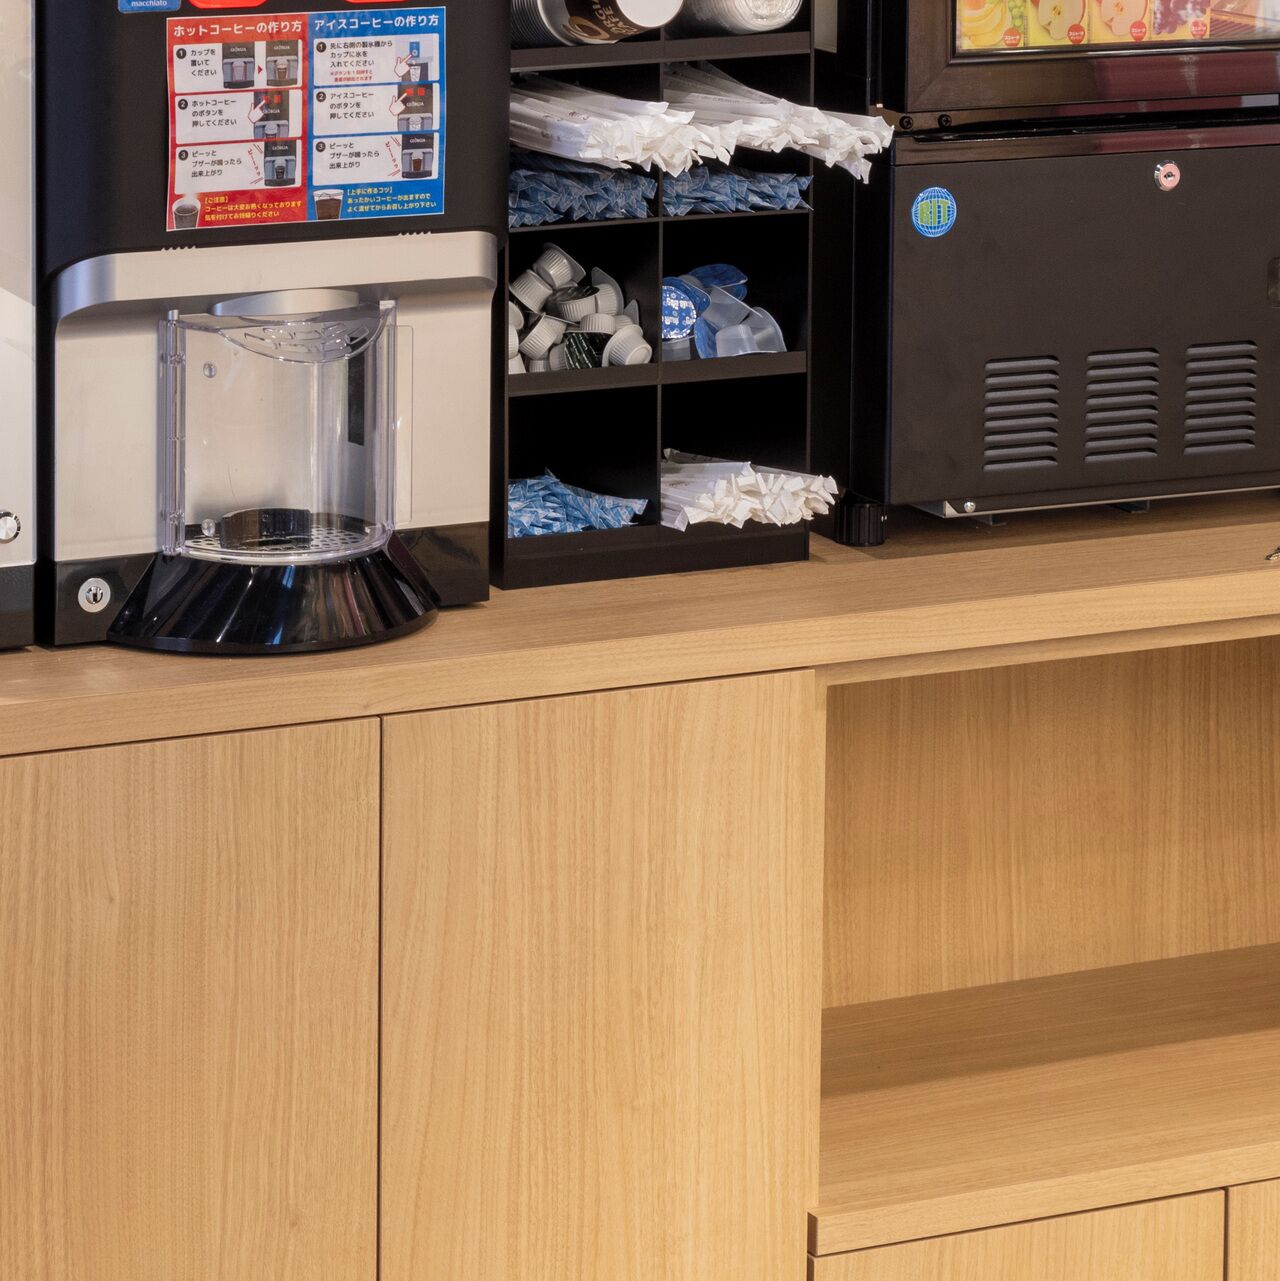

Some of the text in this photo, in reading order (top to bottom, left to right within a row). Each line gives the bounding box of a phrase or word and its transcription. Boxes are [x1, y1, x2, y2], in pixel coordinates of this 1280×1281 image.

[314, 14, 439, 31] アイスコーヒーの作り方
[173, 20, 303, 37] ホットコーヒーの作り方
[190, 49, 216, 57] カップを
[330, 50, 368, 58] カップに氷を
[330, 59, 375, 68] 入れてください
[191, 69, 217, 77] ください
[330, 91, 374, 100] アイスコーヒー
[192, 99, 237, 108] ホットコーヒー
[330, 101, 361, 110] のボタンを
[192, 109, 224, 118] のボタンを
[329, 111, 375, 120] 押してください
[192, 119, 237, 128] 押してください
[329, 161, 361, 170] 出来上がり
[192, 169, 223, 178] 出来上がり
[346, 193, 432, 204] あったかいコーヒーが出ますので
[204, 200, 302, 213] コーヒーは大変お熱くなっております
[346, 201, 437, 213] よく混ぜてからお召し上がり下さい
